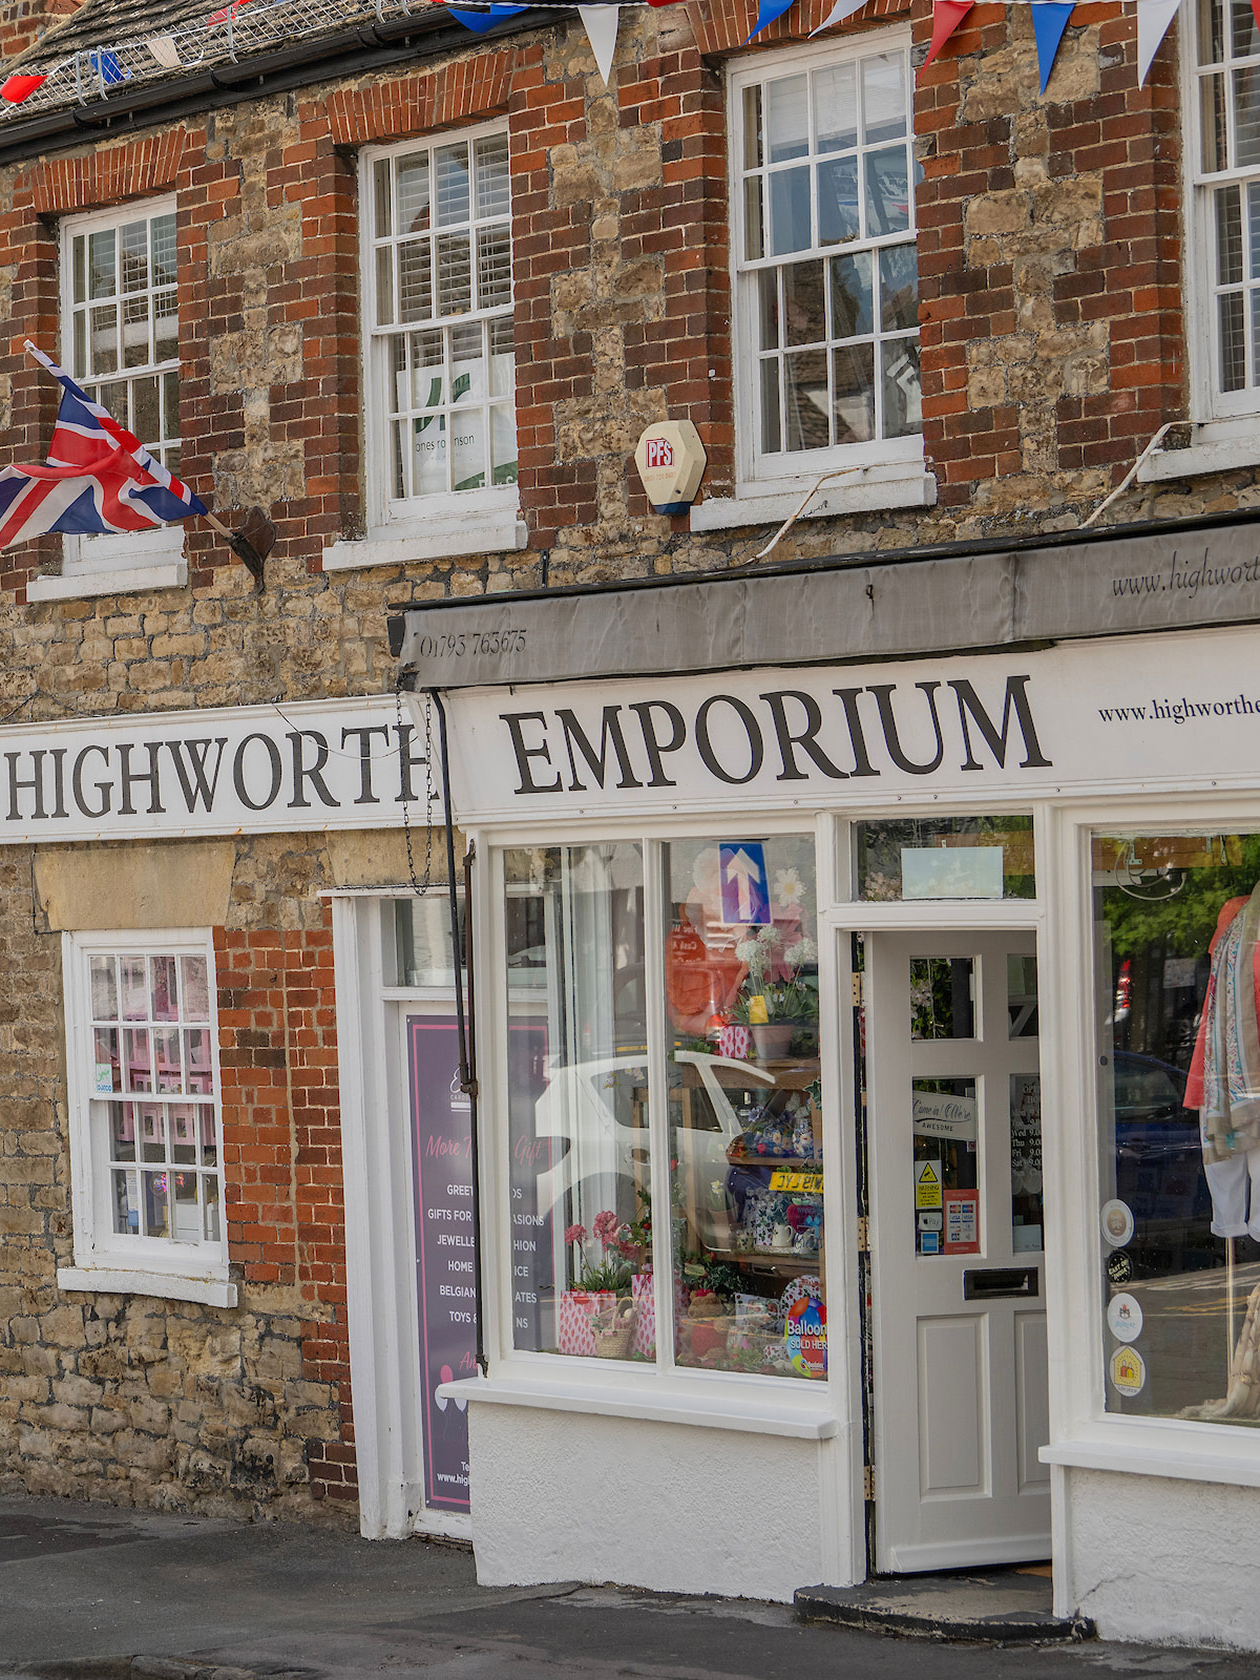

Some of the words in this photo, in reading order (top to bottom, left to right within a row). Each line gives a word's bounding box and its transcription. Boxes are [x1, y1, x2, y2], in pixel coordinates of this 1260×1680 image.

[437, 434, 475, 449] ronson
[648, 440, 672, 467] PFS
[1112, 547, 1260, 599] www.highwort
[420, 634, 466, 658] 01793
[472, 629, 527, 656] 763675
[498, 674, 1053, 795] EMPORIUM
[3, 723, 440, 821] HIGHWORTH
[921, 1122, 954, 1132] AWESOME
[1011, 1129, 1027, 1138] Wed
[1012, 1139, 1026, 1147] Thu
[425, 1135, 460, 1159] More
[514, 1136, 541, 1168] Gift
[1012, 1149, 1022, 1157] Fri
[427, 1208, 452, 1220] GIFTS
[454, 1210, 472, 1222] FOR
[448, 1260, 473, 1272] HOME
[440, 1285, 477, 1298] BELGIAN
[449, 1311, 471, 1324] TOYS
[787, 1319, 827, 1336] Balloon
[790, 1339, 811, 1350] SOLD
